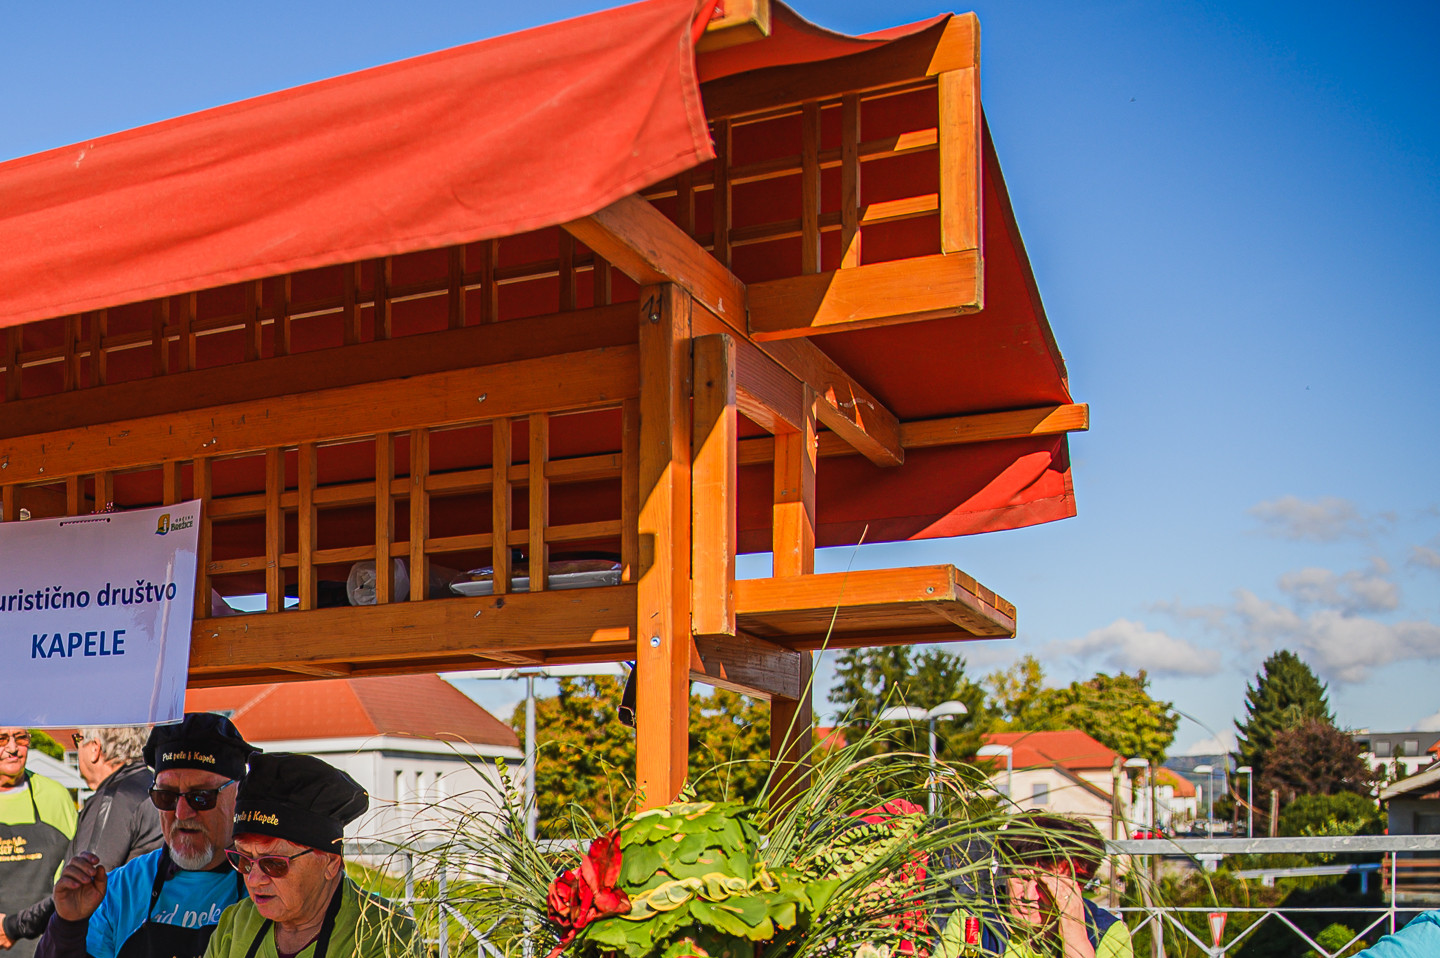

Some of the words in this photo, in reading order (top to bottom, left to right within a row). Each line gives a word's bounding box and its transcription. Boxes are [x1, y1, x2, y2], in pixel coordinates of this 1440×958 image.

[97, 579, 177, 606] društvo
[31, 630, 126, 659] KAPELE
[253, 811, 279, 825] Kapele
